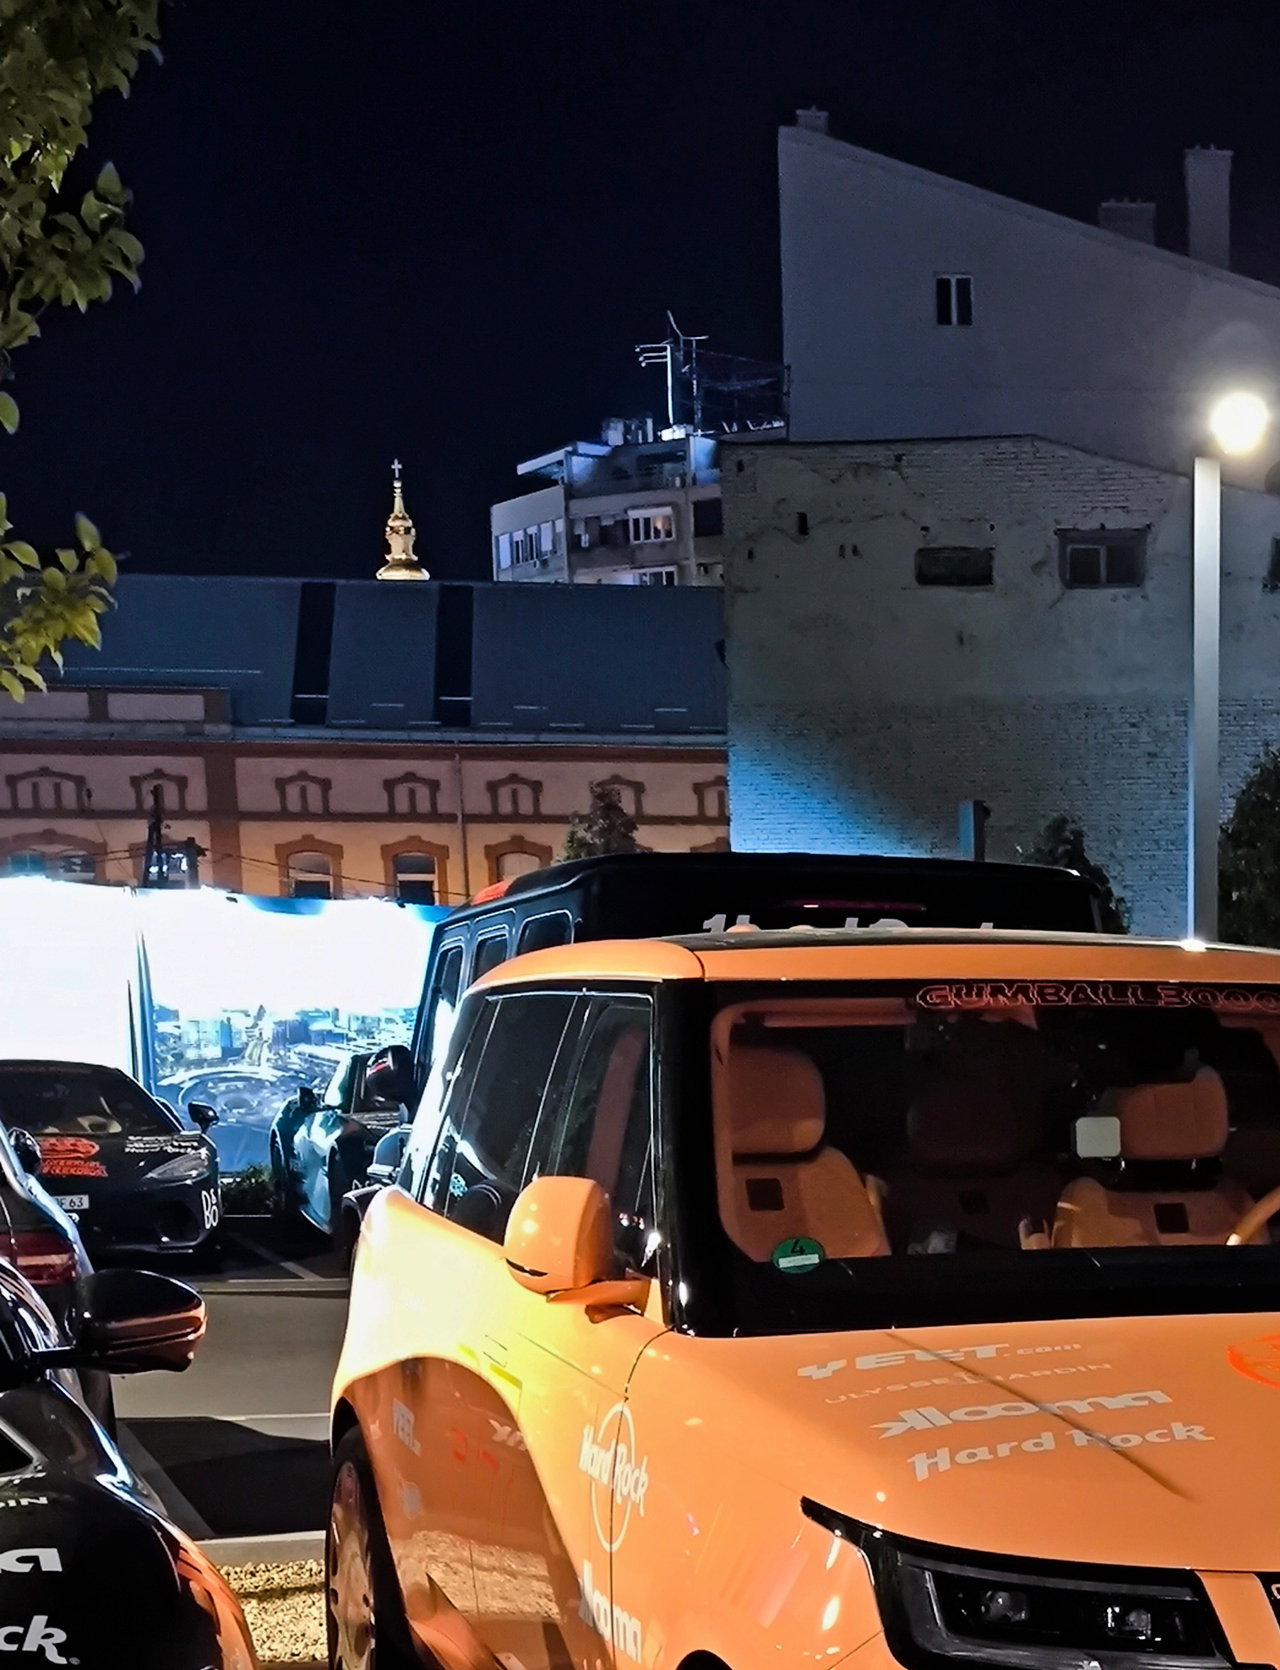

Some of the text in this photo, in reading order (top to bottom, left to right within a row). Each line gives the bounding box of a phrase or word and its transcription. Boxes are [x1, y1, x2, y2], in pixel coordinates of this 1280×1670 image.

[69, 1198, 84, 1208] 63
[791, 1238, 806, 1256] 4
[797, 1343, 1081, 1380] YEET.com
[578, 1424, 616, 1486] Hard
[614, 1443, 648, 1517] Rock
[907, 1422, 1215, 1482] Hard Rock
